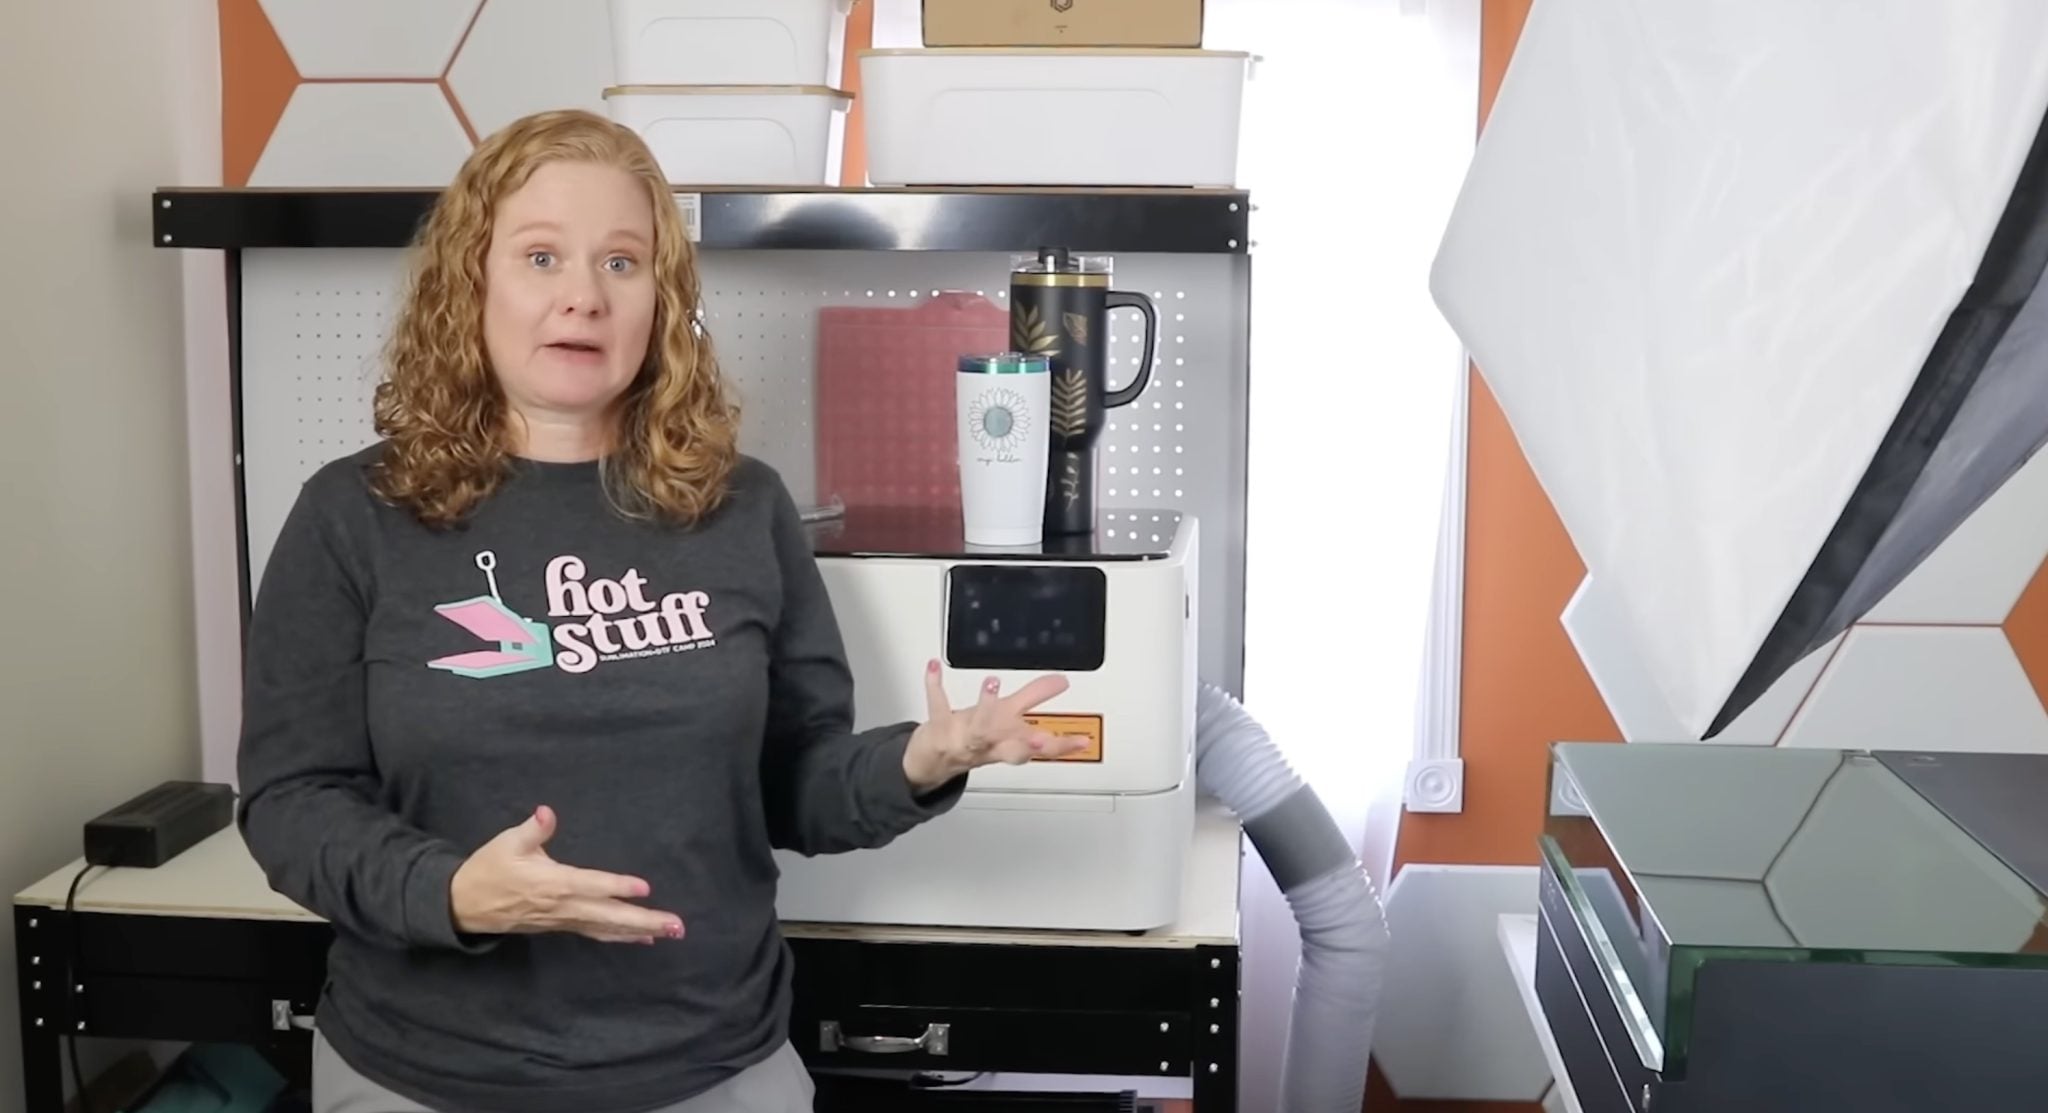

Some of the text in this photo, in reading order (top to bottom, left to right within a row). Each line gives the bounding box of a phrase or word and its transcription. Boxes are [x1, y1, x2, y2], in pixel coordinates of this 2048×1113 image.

[545, 555, 656, 617] hot
[553, 591, 713, 673] stuff
[672, 643, 696, 653] CAMP
